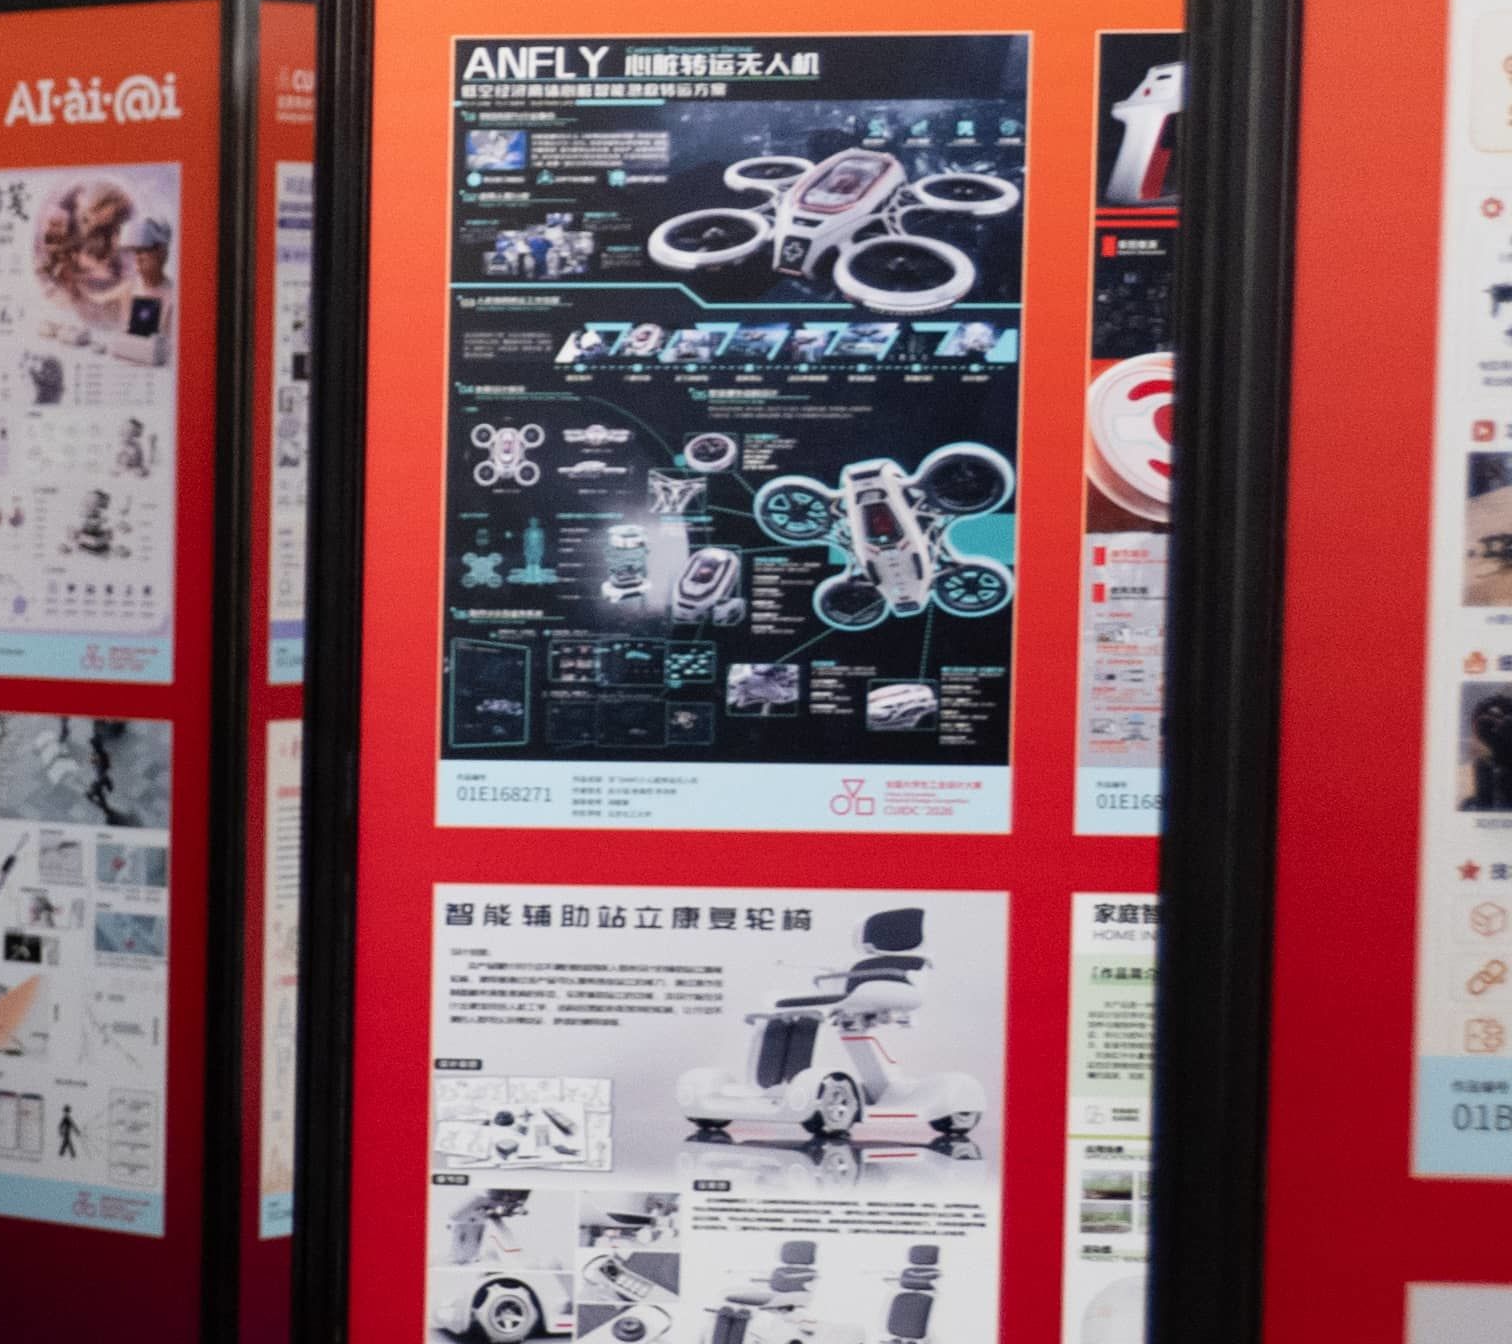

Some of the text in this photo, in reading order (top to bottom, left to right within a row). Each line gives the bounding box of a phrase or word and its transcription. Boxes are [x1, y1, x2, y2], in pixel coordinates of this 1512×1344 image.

[463, 44, 820, 80] ANFLY 心脏转运无人机
[444, 902, 813, 933] 智能辅助站立康复轮椅
[1094, 929, 1136, 941] HOME
